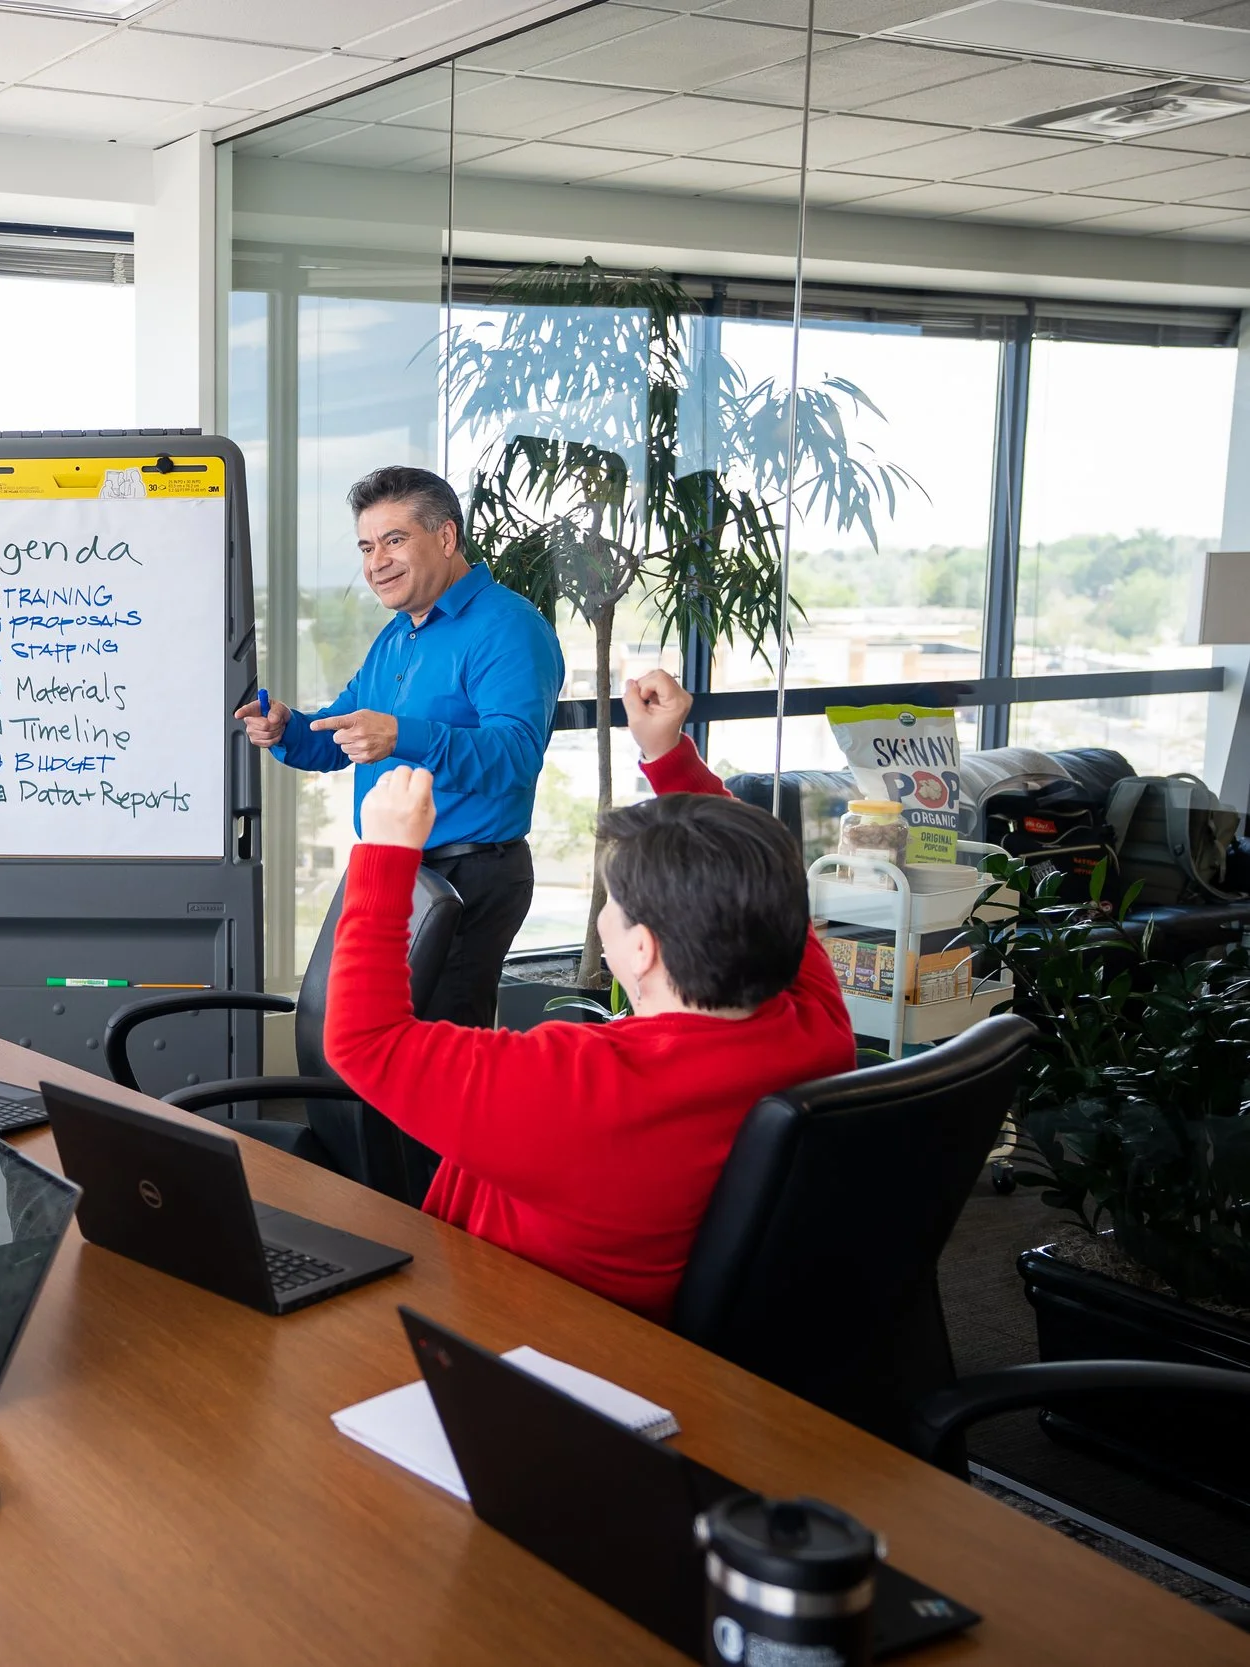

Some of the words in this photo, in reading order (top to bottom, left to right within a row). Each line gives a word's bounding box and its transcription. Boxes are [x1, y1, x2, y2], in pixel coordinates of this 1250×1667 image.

[3, 585, 113, 608] TRAINING
[9, 611, 142, 639] PROPOSALS
[11, 638, 118, 663] STAFFING
[17, 672, 127, 710] Materials
[9, 715, 131, 750] Timeline
[15, 753, 116, 774] BUDGET
[882, 770, 960, 810] POP
[911, 811, 957, 829] ORGANIC
[920, 831, 953, 845] ORIGINAL
[923, 843, 948, 852] POPCORN
